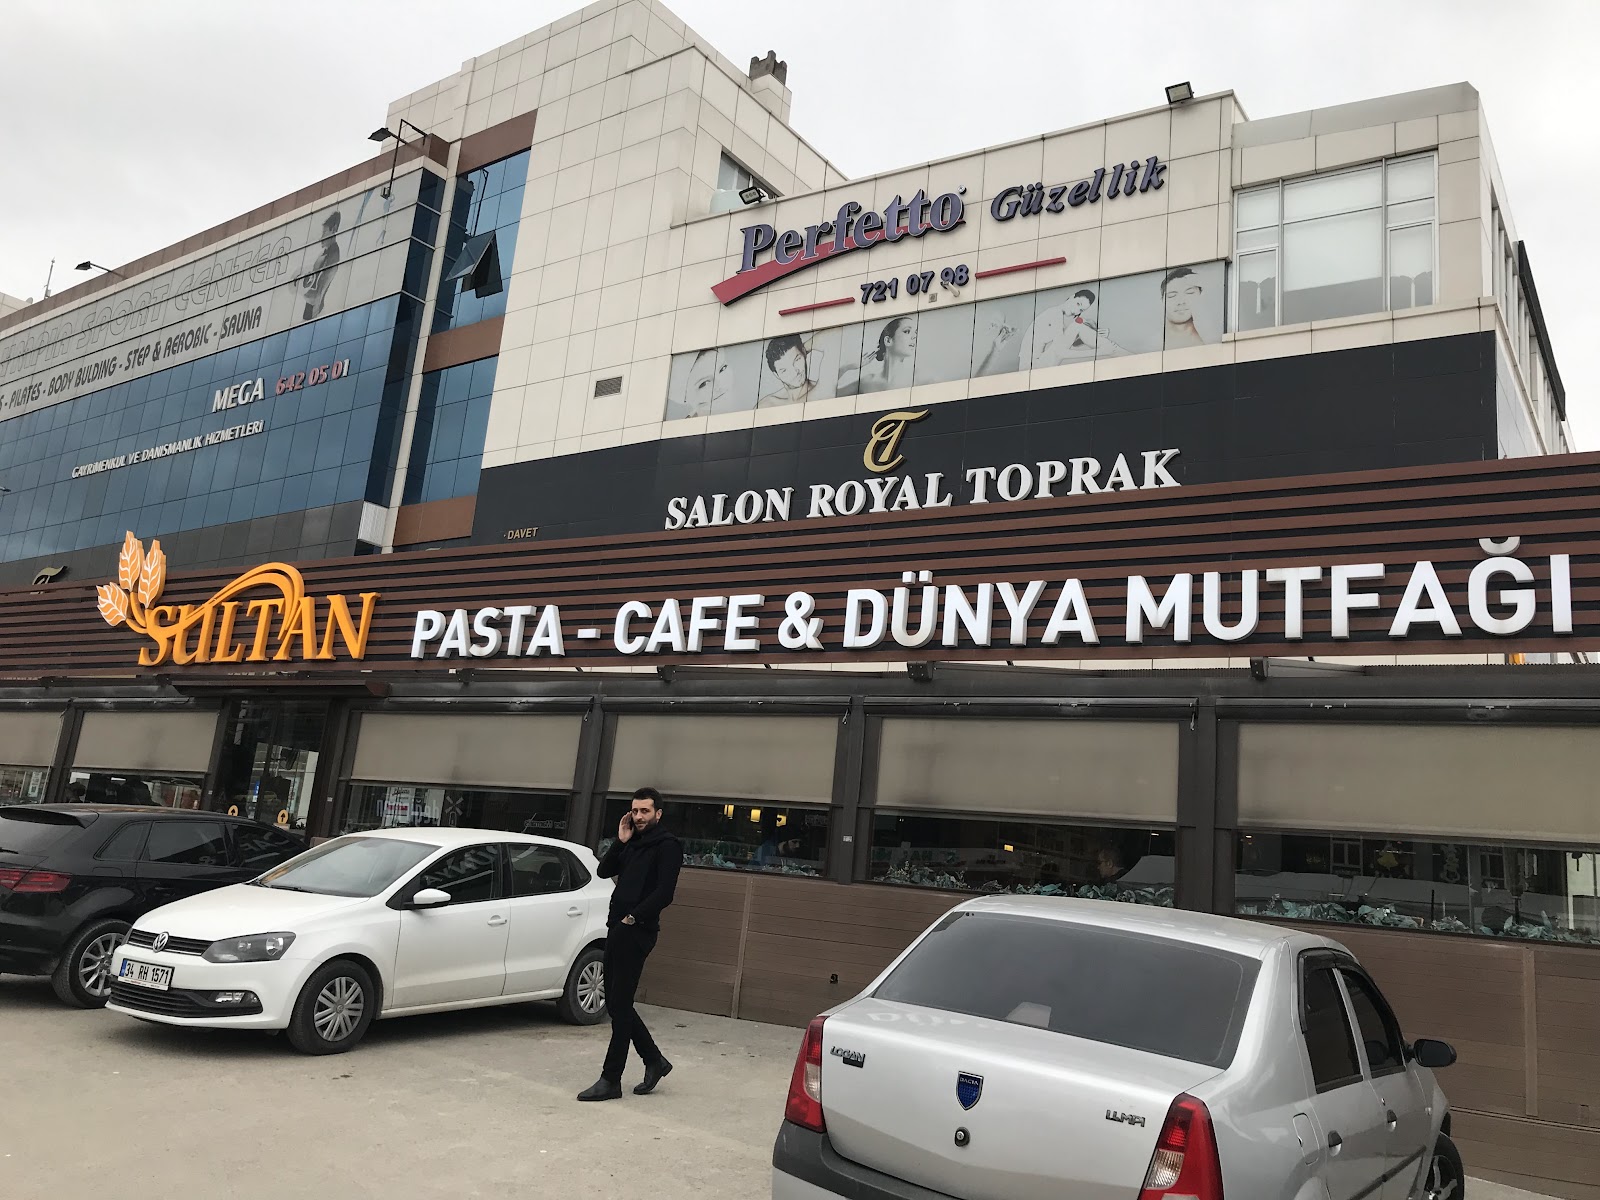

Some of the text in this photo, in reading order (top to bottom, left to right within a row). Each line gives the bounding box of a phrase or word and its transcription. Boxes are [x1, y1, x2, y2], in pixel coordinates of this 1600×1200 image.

[736, 156, 1167, 274] Perfetto Güzellik
[76, 284, 169, 349] SPORT
[174, 236, 292, 311] CENTER
[861, 264, 969, 304] 721 07 98
[8, 381, 43, 409] PILATES
[47, 370, 75, 396] BODY
[74, 356, 117, 388] BULDING
[124, 344, 151, 371] STEP
[152, 341, 161, 361] &
[163, 322, 212, 358] AEROBIC
[220, 306, 263, 340] SAUNA
[212, 359, 350, 413] MEGA 642 05 01
[129, 451, 141, 465] VE
[664, 448, 1182, 531] SALON ROYAL TOPRAK
[507, 527, 538, 540] DAVET
[411, 604, 565, 659] PASTA
[613, 594, 764, 655] CAFE
[777, 591, 824, 650] &
[843, 570, 1099, 648] DÜNYA
[1125, 536, 1574, 644] MUTFAĞI
[138, 592, 381, 666] SULTAN
[125, 963, 134, 977] 34
[138, 966, 149, 980] RH
[151, 967, 169, 984] 1571
[830, 1046, 866, 1062] LOGAN
[959, 1077, 979, 1086] DACIA
